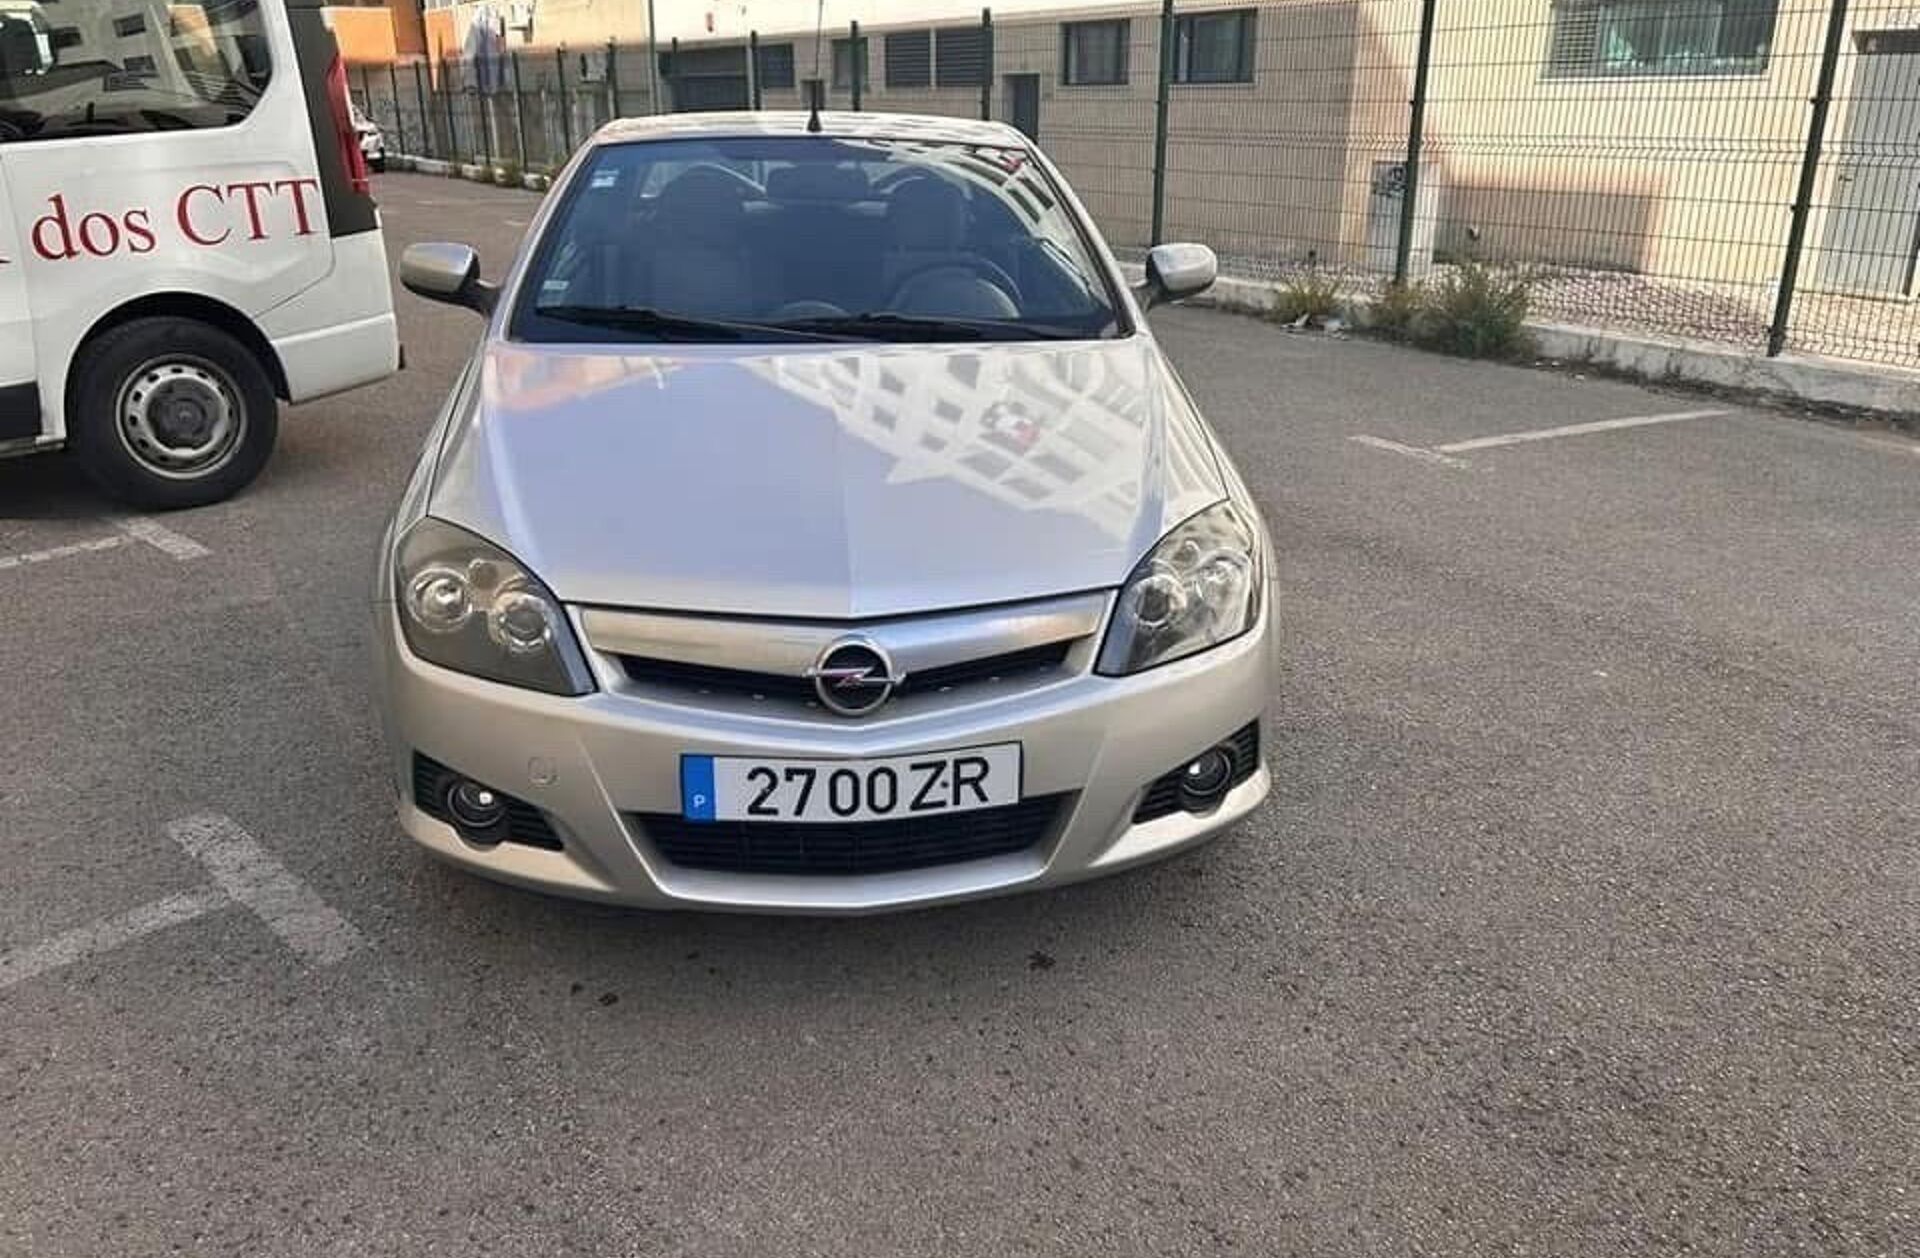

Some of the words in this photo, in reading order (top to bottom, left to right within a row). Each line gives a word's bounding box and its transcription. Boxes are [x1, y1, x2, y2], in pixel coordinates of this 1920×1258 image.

[31, 194, 156, 260] dos
[176, 178, 318, 245] CTT
[693, 794, 705, 808] P
